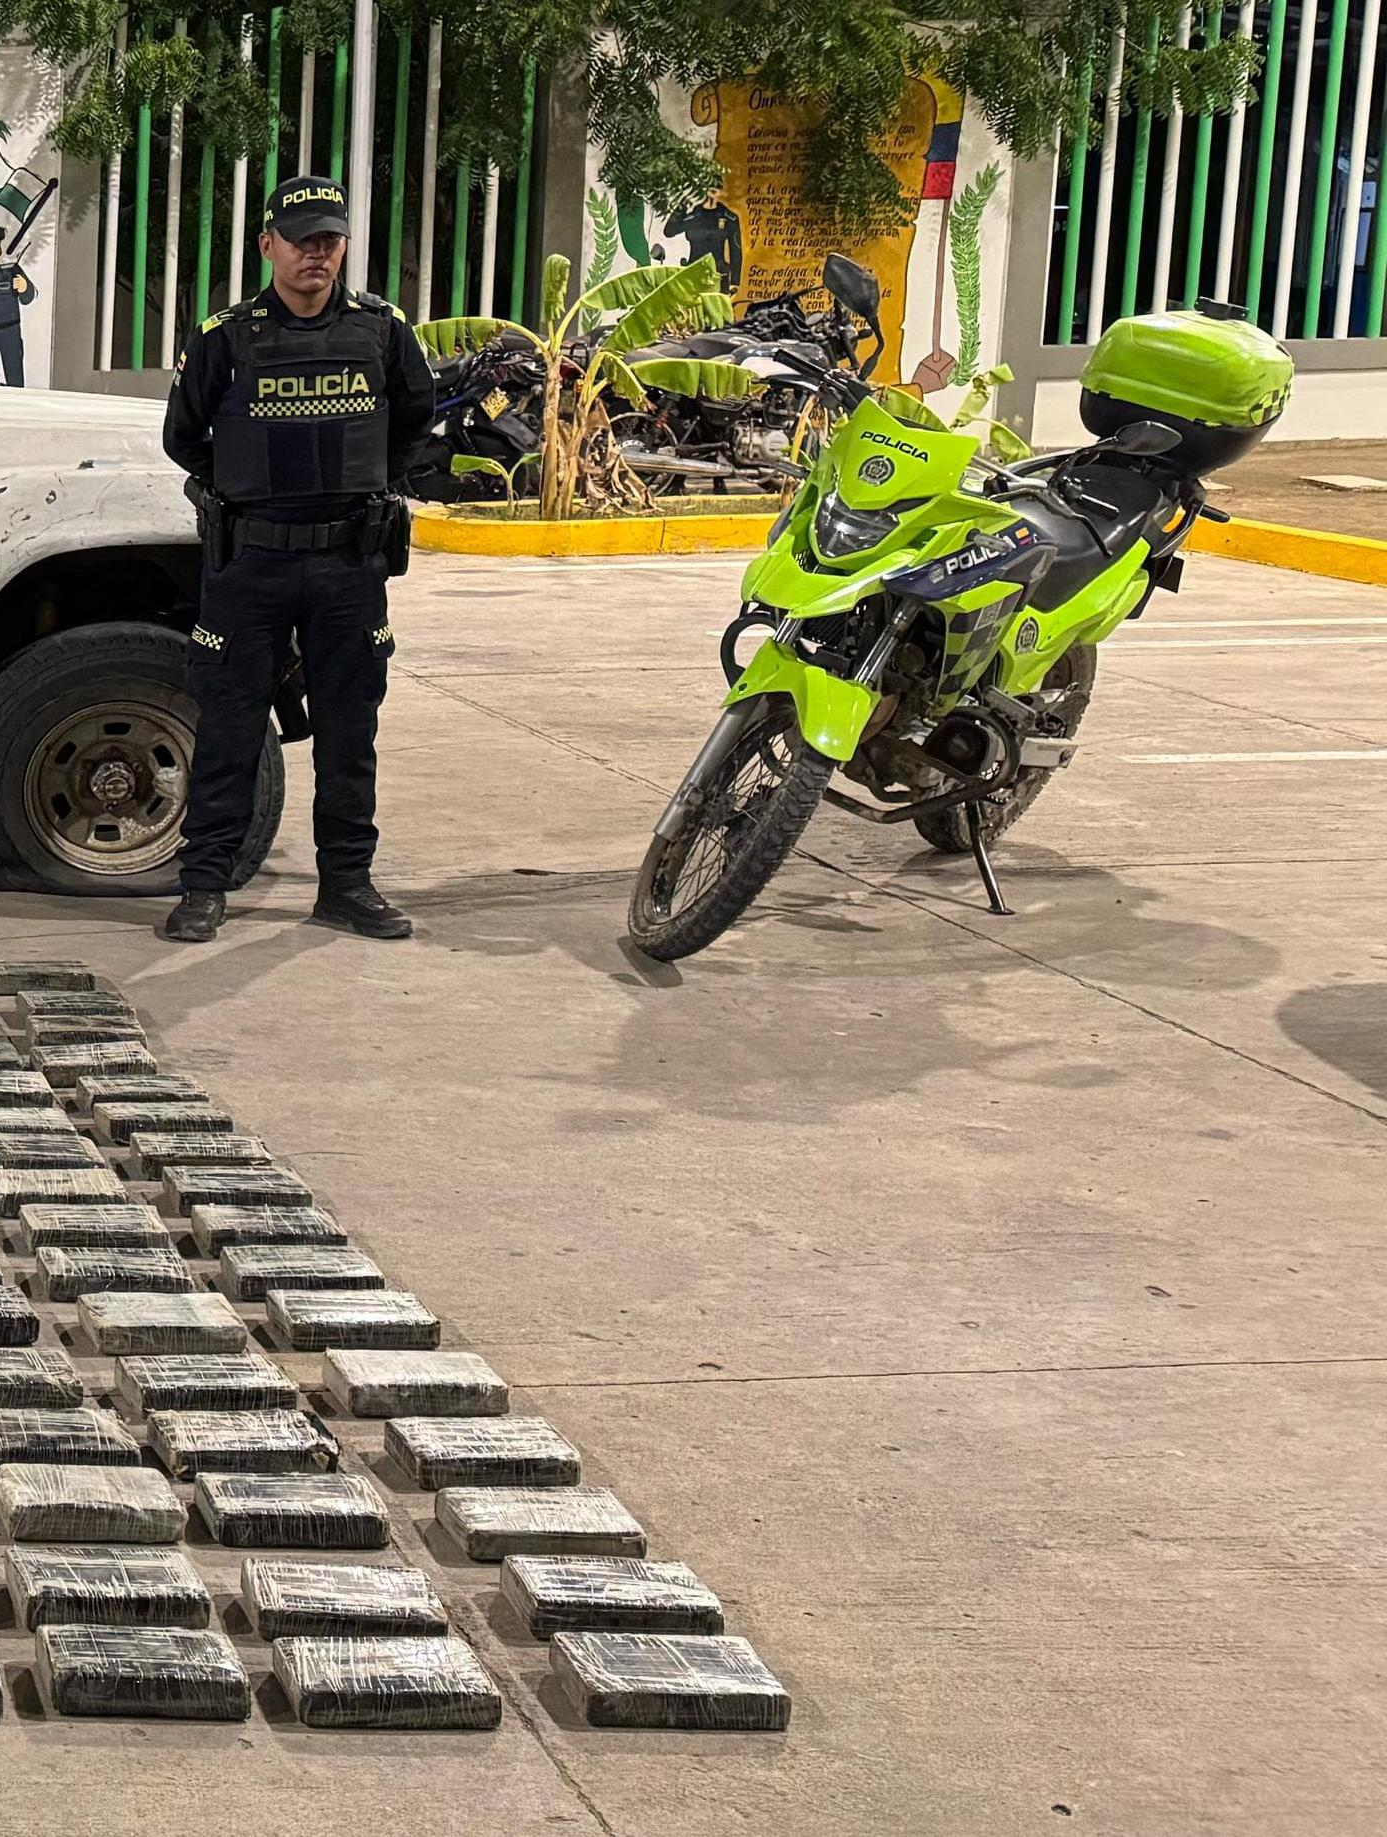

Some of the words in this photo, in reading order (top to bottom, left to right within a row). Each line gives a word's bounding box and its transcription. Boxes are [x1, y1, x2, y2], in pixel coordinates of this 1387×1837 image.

[282, 187, 344, 208] POLICÍA
[258, 367, 370, 398] POLICÍA
[860, 431, 930, 463] POLICIA
[946, 534, 1017, 575] POLIC
